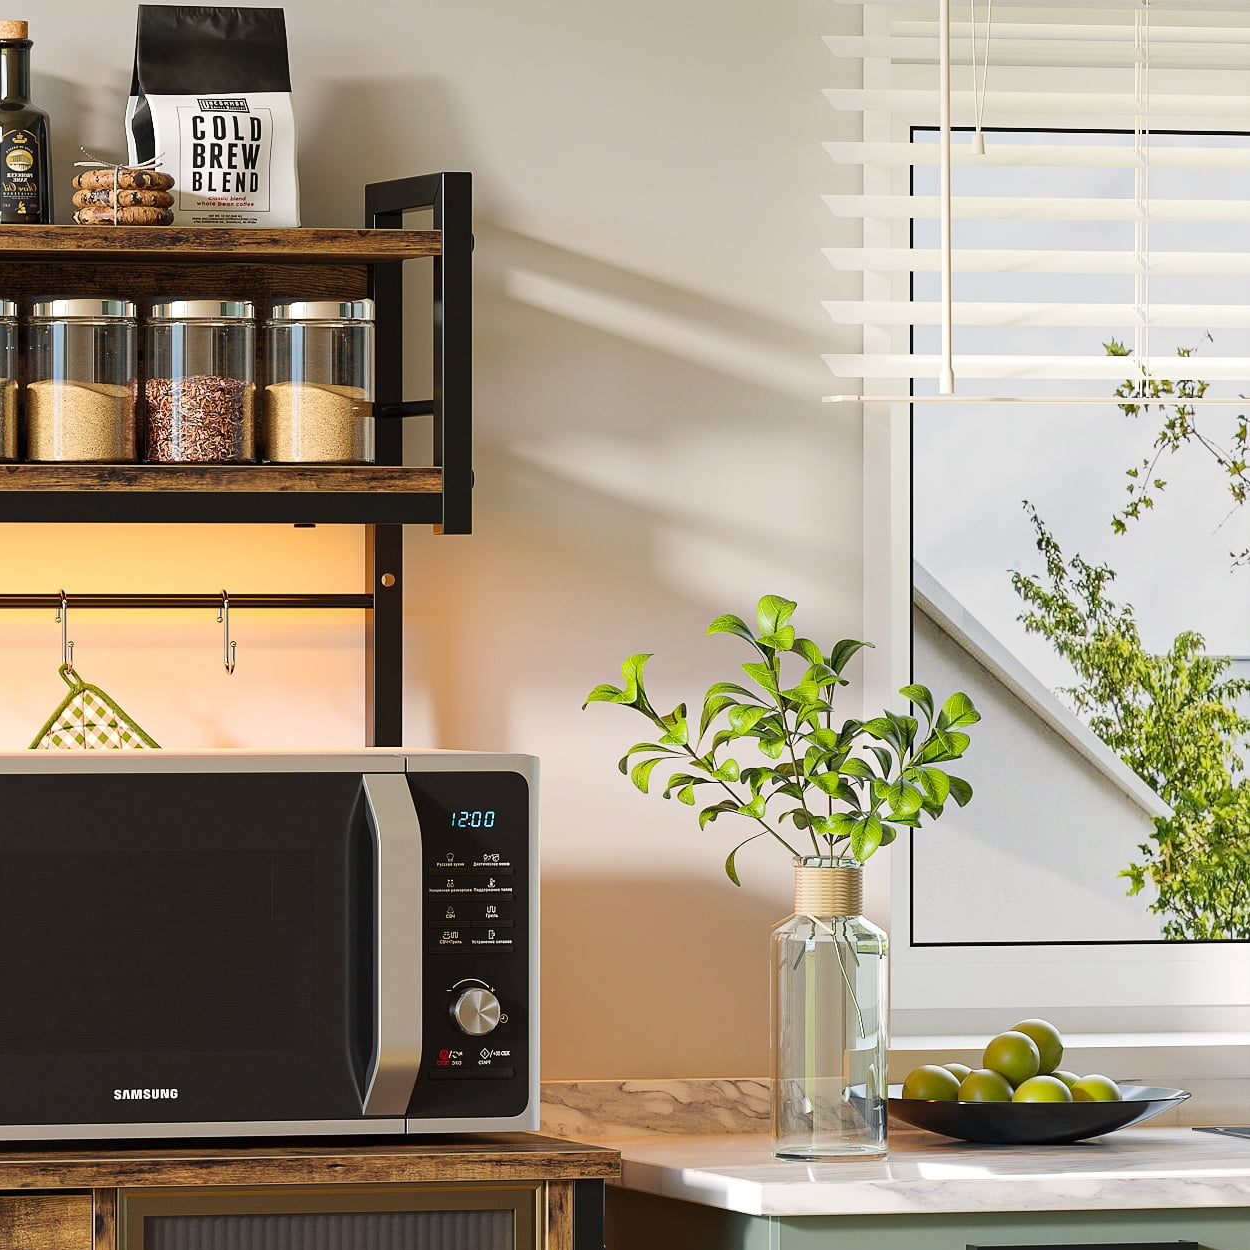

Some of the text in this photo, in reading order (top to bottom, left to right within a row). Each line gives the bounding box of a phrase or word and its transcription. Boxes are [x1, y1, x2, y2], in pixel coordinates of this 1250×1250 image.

[192, 115, 262, 141] COLD
[192, 143, 261, 170] BREW
[192, 171, 259, 193] BLEND
[451, 811, 496, 828] 12:00
[113, 1088, 179, 1100] SAMSUNG
